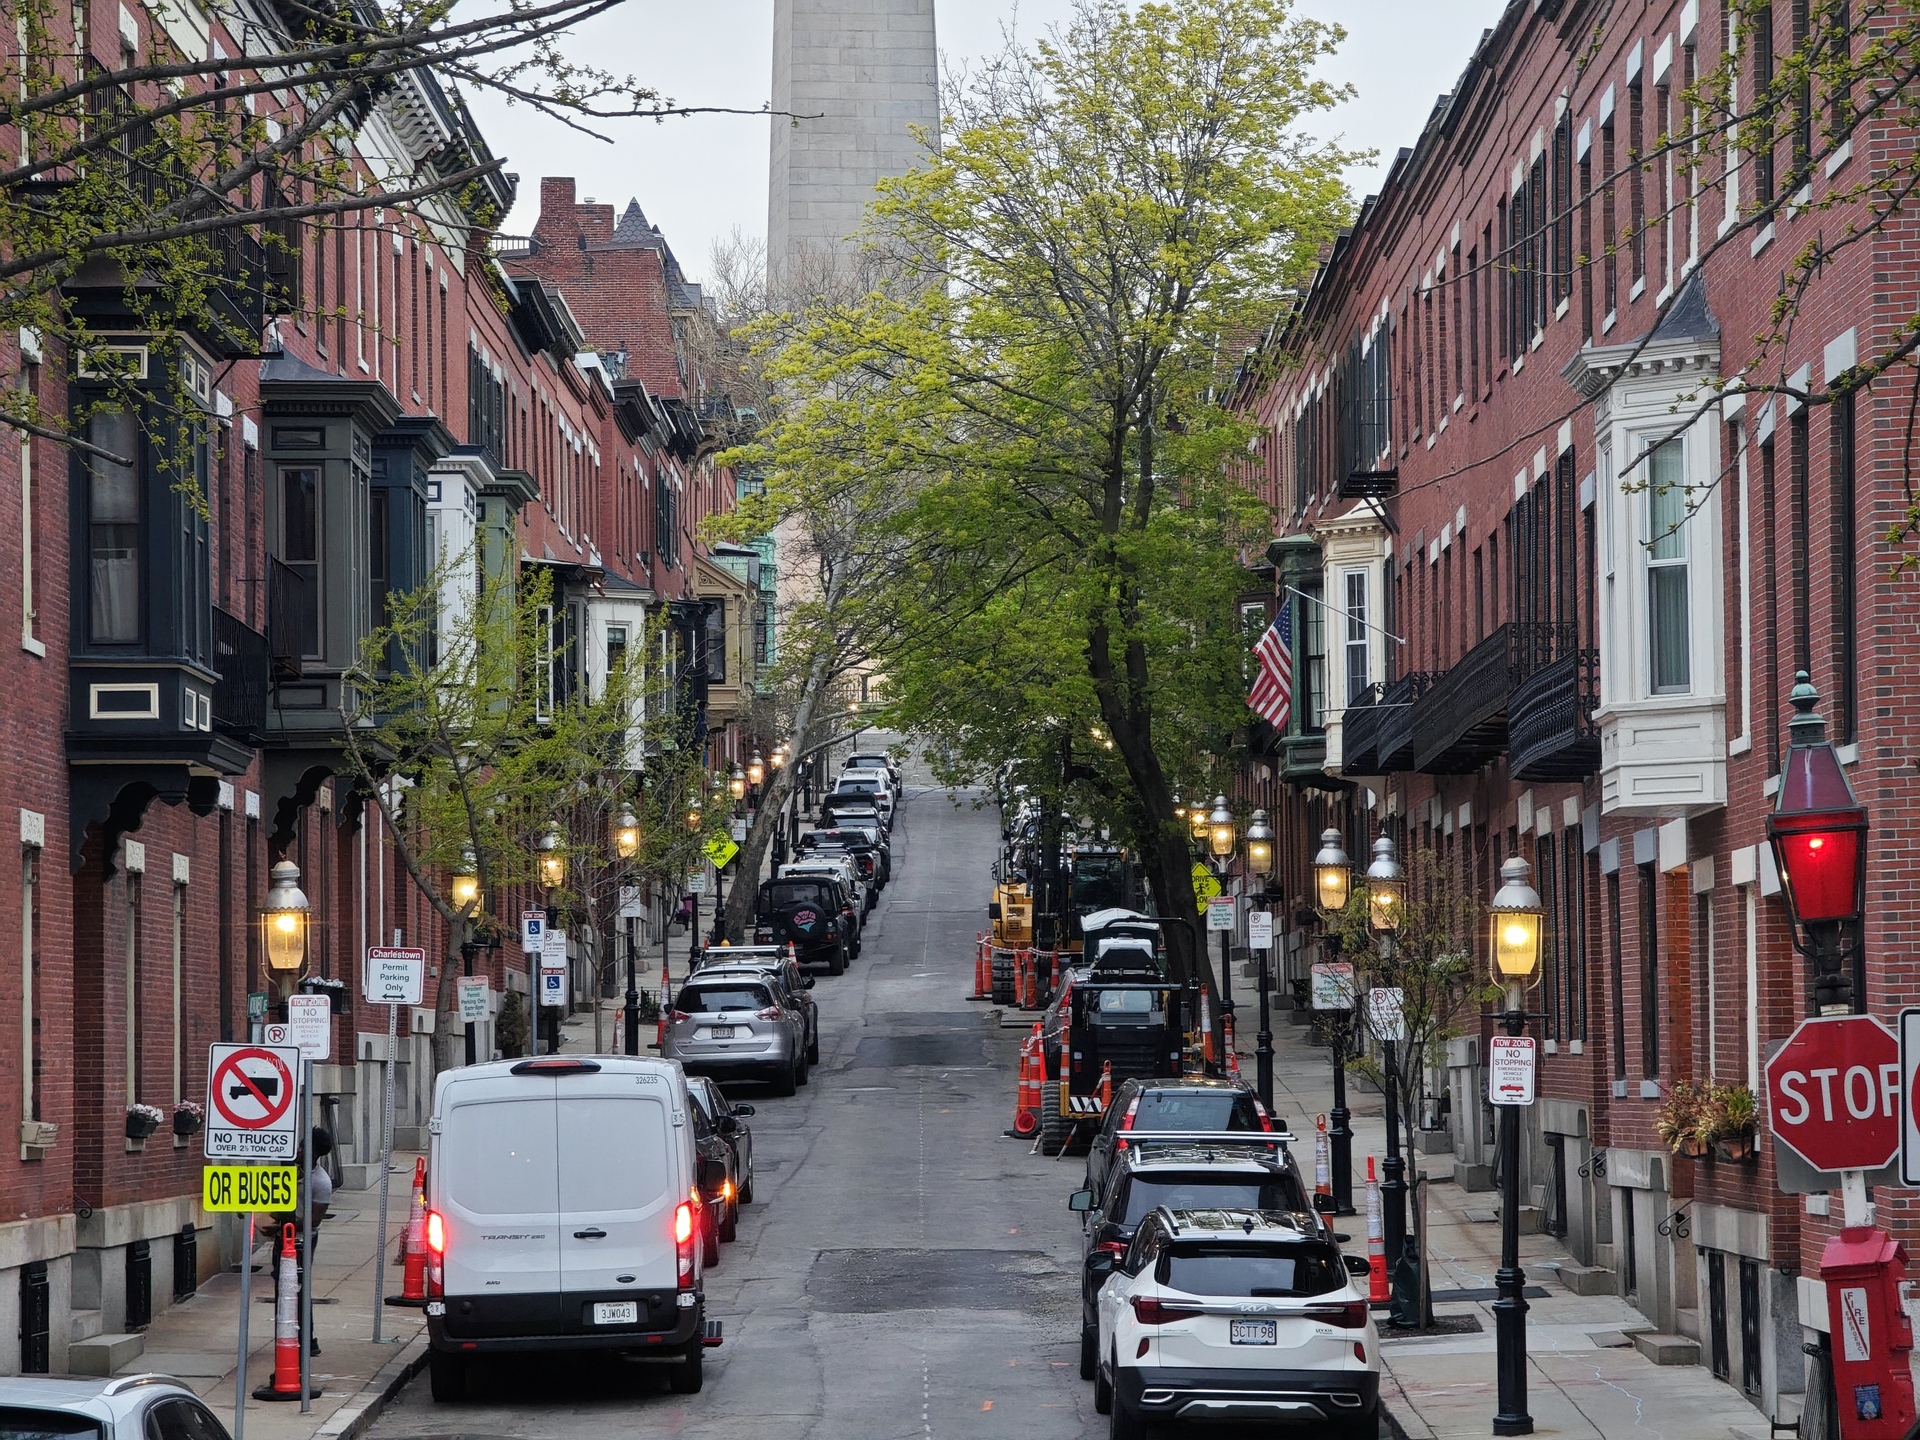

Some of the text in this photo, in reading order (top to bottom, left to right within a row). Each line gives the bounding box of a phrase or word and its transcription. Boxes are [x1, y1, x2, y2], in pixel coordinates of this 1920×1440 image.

[372, 950, 420, 959] Charlestown
[380, 974, 410, 982] Parking
[385, 984, 403, 992] Only
[1506, 1050, 1520, 1058] NO
[636, 1076, 658, 1084] 326235
[214, 1133, 288, 1145] NO TRUCKS
[210, 1171, 291, 1205] OR BUSES
[602, 1308, 630, 1318] 3JW043
[1848, 1292, 1865, 1325] FIRE
[1233, 1326, 1273, 1338] 3CTT 98
[1845, 1311, 1864, 1356] EMERGENCY
